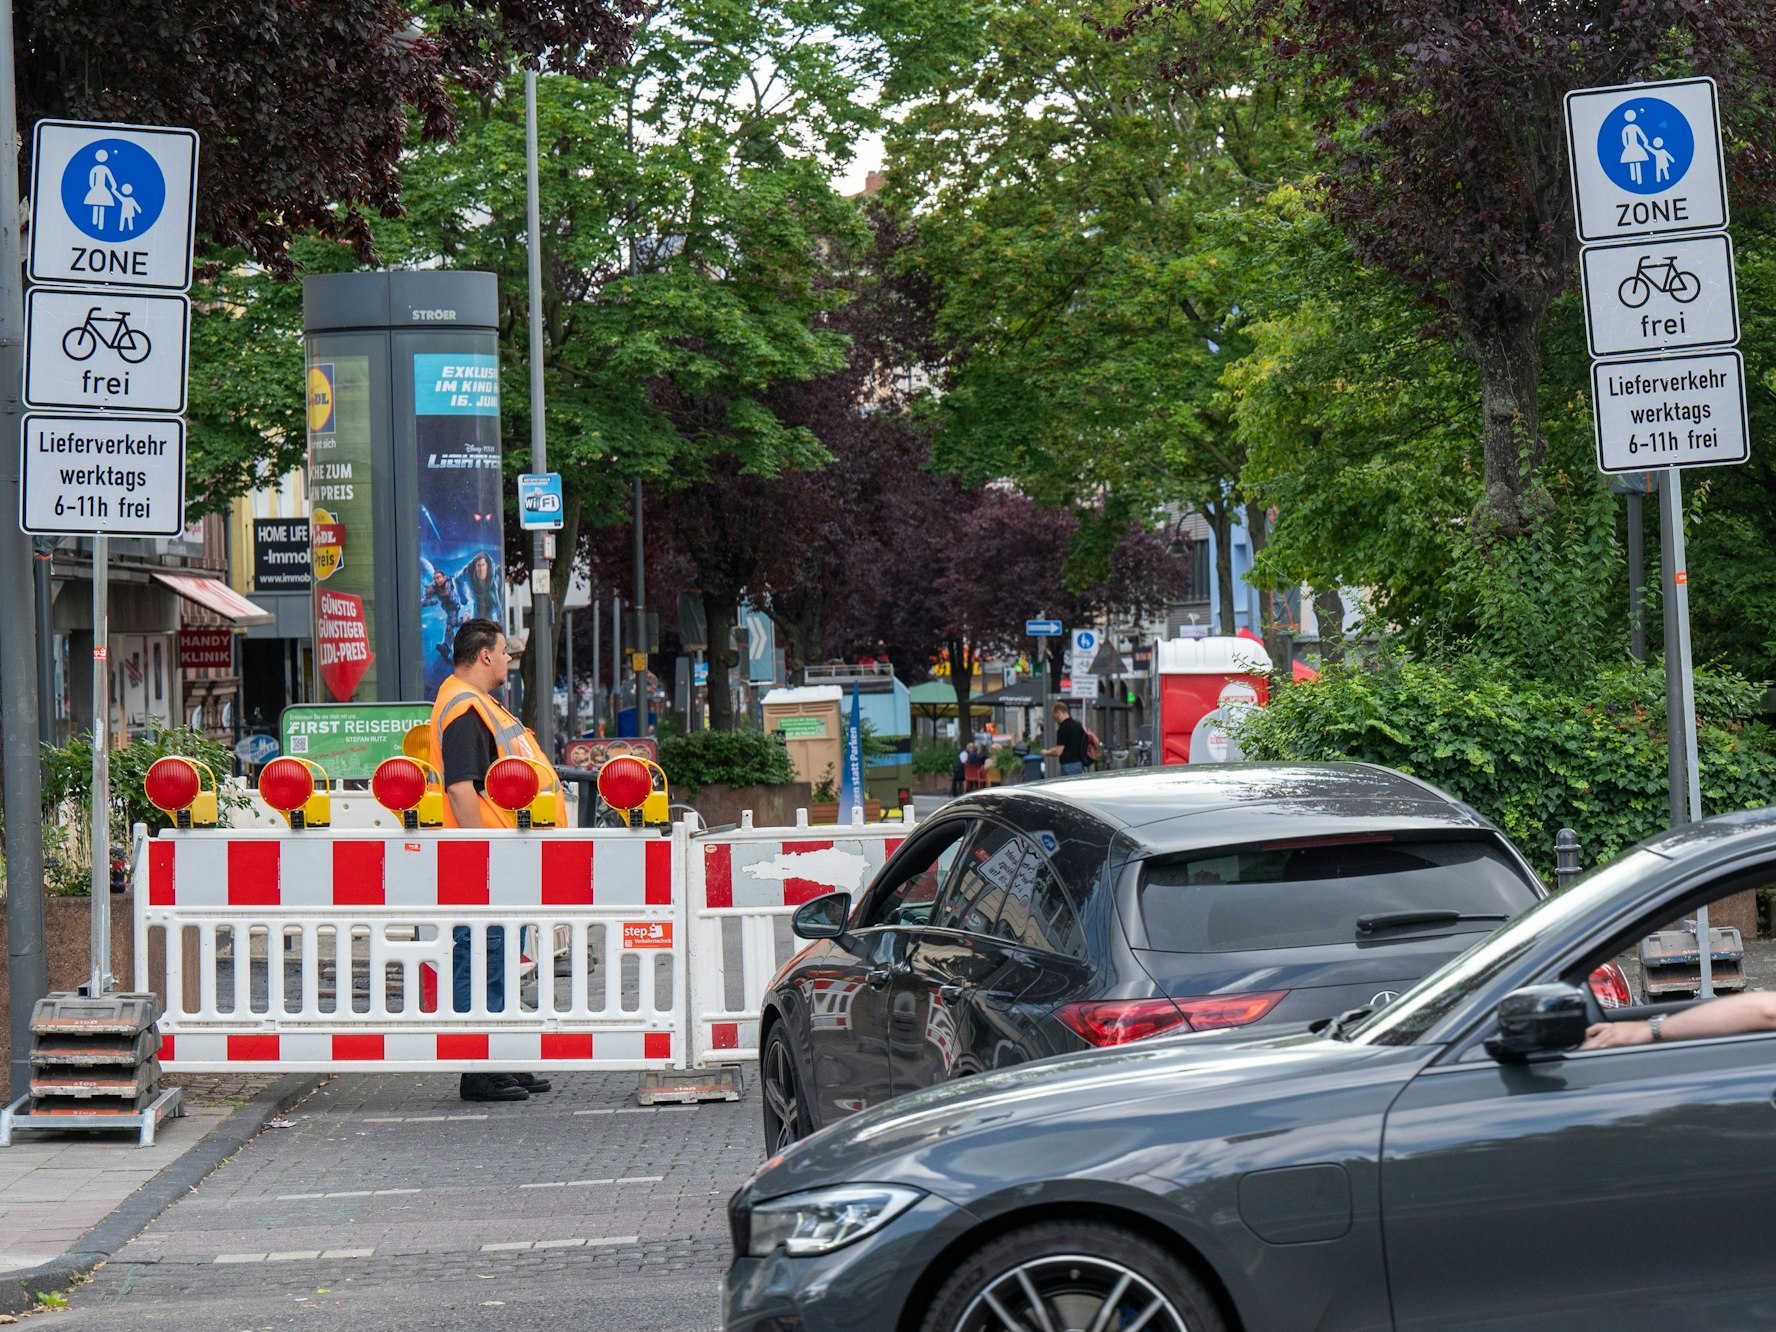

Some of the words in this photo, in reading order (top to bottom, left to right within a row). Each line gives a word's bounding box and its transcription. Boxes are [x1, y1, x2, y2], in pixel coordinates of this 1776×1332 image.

[1616, 197, 1689, 227] ZONE
[70, 247, 149, 276] ZONE
[412, 309, 457, 321] STRÖER
[1641, 312, 1686, 337] frei
[82, 371, 130, 395] frei
[435, 381, 457, 393] IM
[1608, 369, 1728, 397] Lieferverkehr
[450, 395, 473, 407] 16.
[1631, 403, 1712, 425] werktags
[39, 431, 167, 456] Lieferverkehr
[1628, 431, 1678, 455] 6-11h
[1688, 427, 1718, 450] frei
[60, 466, 147, 492] werktags
[325, 463, 352, 480] ZUM
[320, 484, 354, 501] PREIS
[54, 495, 108, 518] 6-11h
[119, 496, 151, 519] frei
[258, 526, 287, 543] HOME
[290, 525, 308, 542] LIFE
[321, 594, 357, 618] GÜNSTIG
[318, 616, 365, 639] GÜNSTIGER
[180, 635, 231, 648] HANDY
[180, 651, 231, 663] KLINIK
[319, 642, 367, 666] LIDL-PREIS
[287, 721, 340, 734] FIRST
[848, 726, 859, 762] Parken
[850, 762, 860, 786] statt
[624, 926, 648, 939] step
